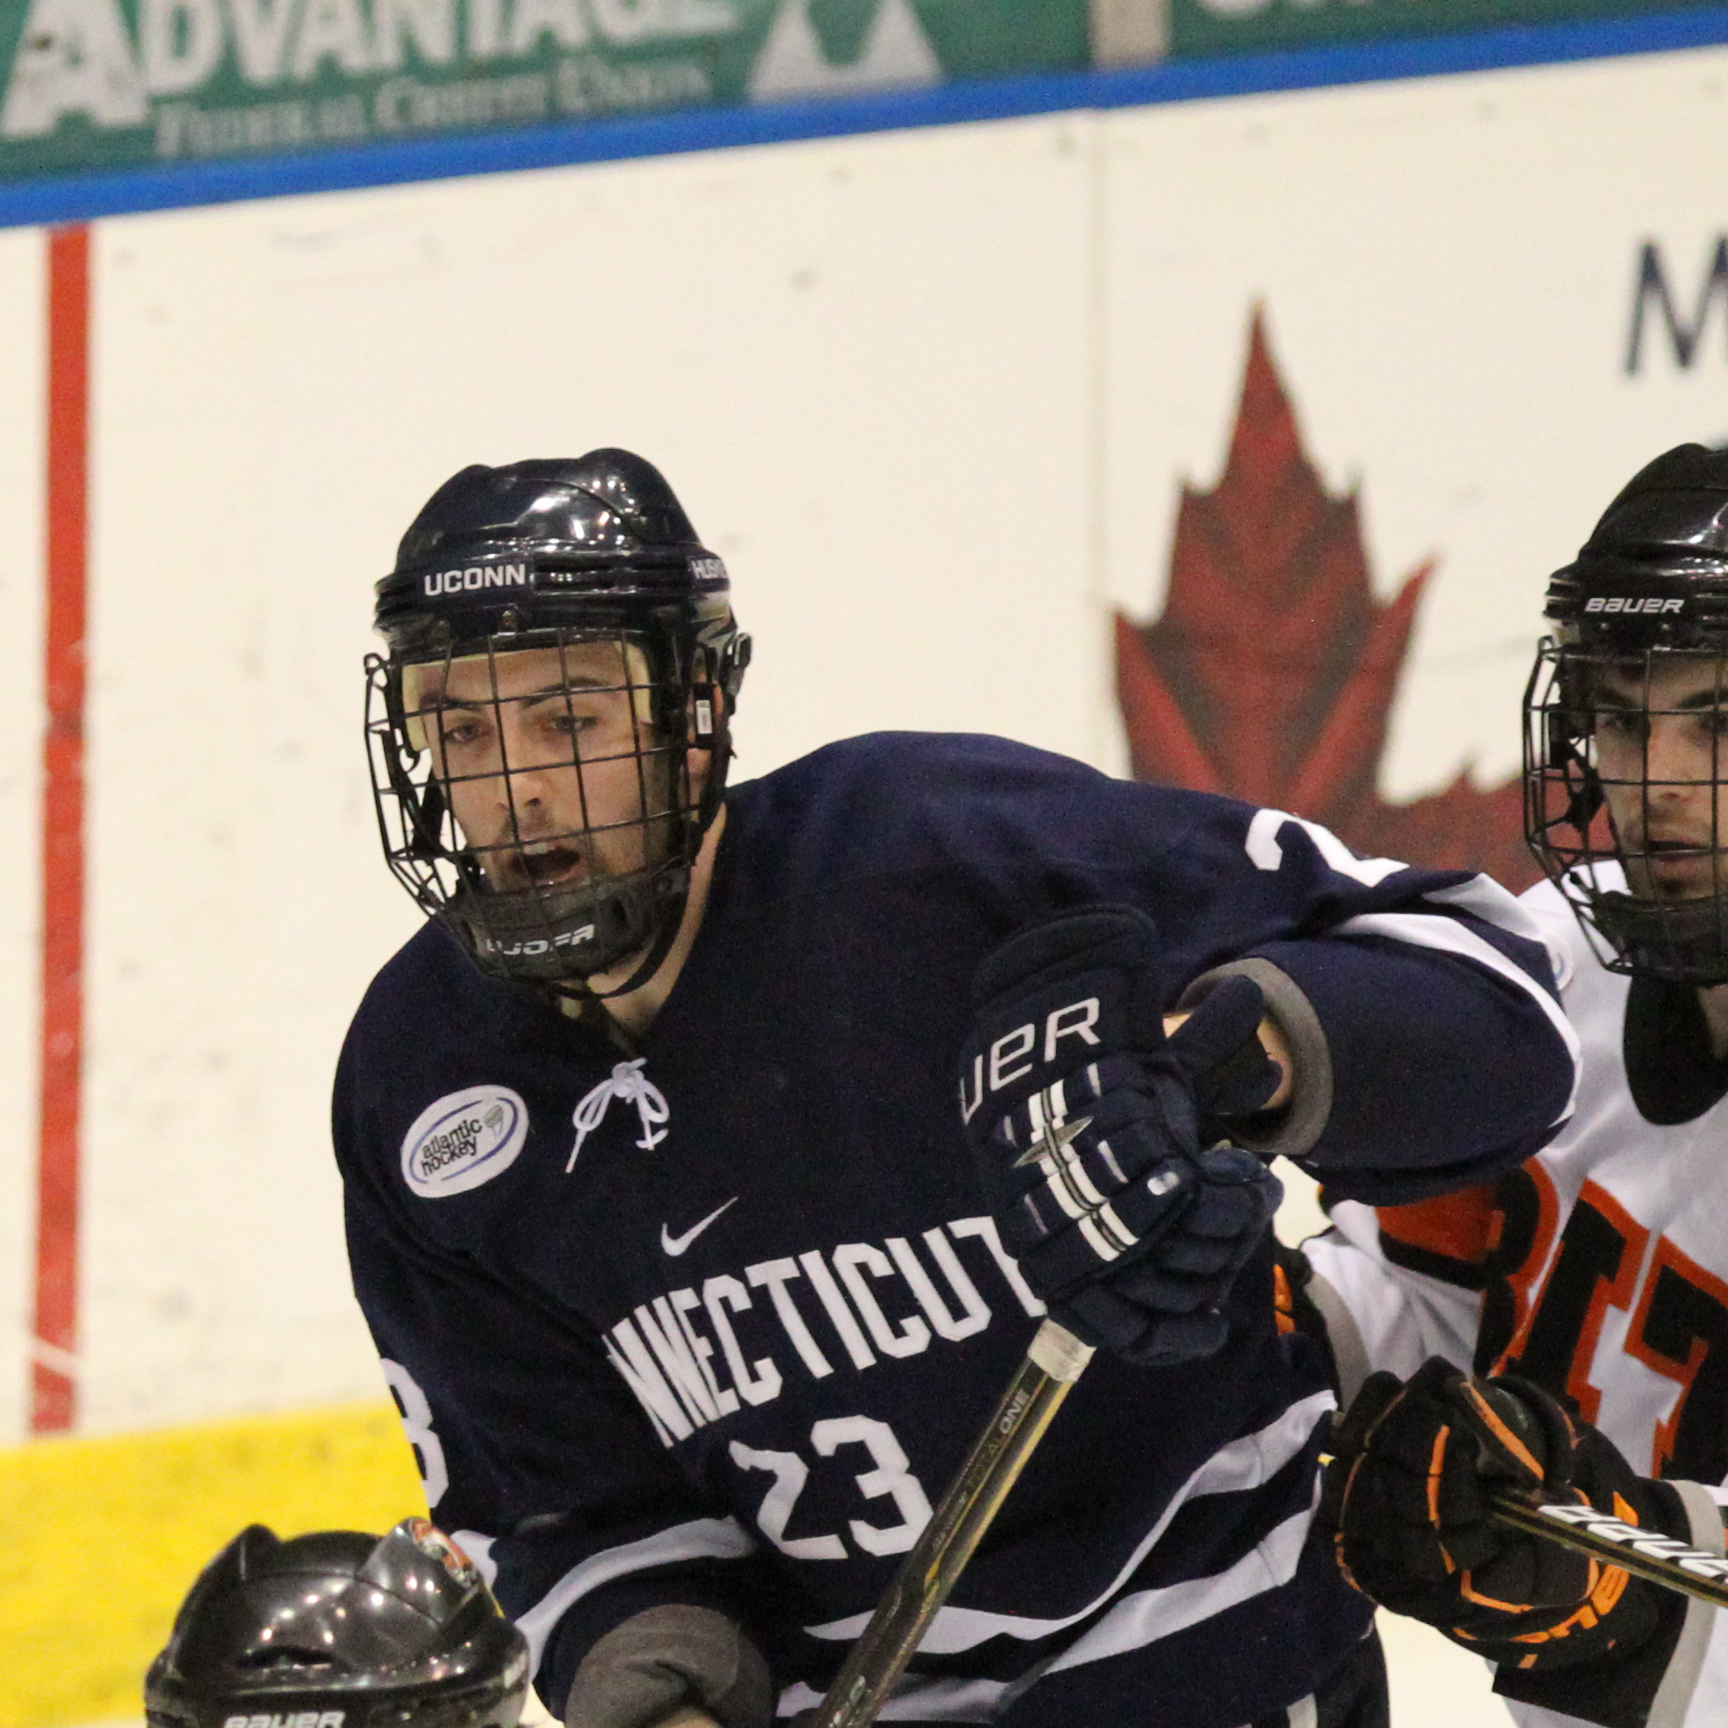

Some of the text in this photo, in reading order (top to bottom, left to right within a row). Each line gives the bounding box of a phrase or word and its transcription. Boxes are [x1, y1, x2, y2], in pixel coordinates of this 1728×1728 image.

[423, 563, 526, 598] UCONN
[420, 1136, 478, 1176] hockey
[421, 1118, 483, 1159] atlantic
[998, 1388, 1032, 1435] ONE
[727, 1414, 935, 1560] 23
